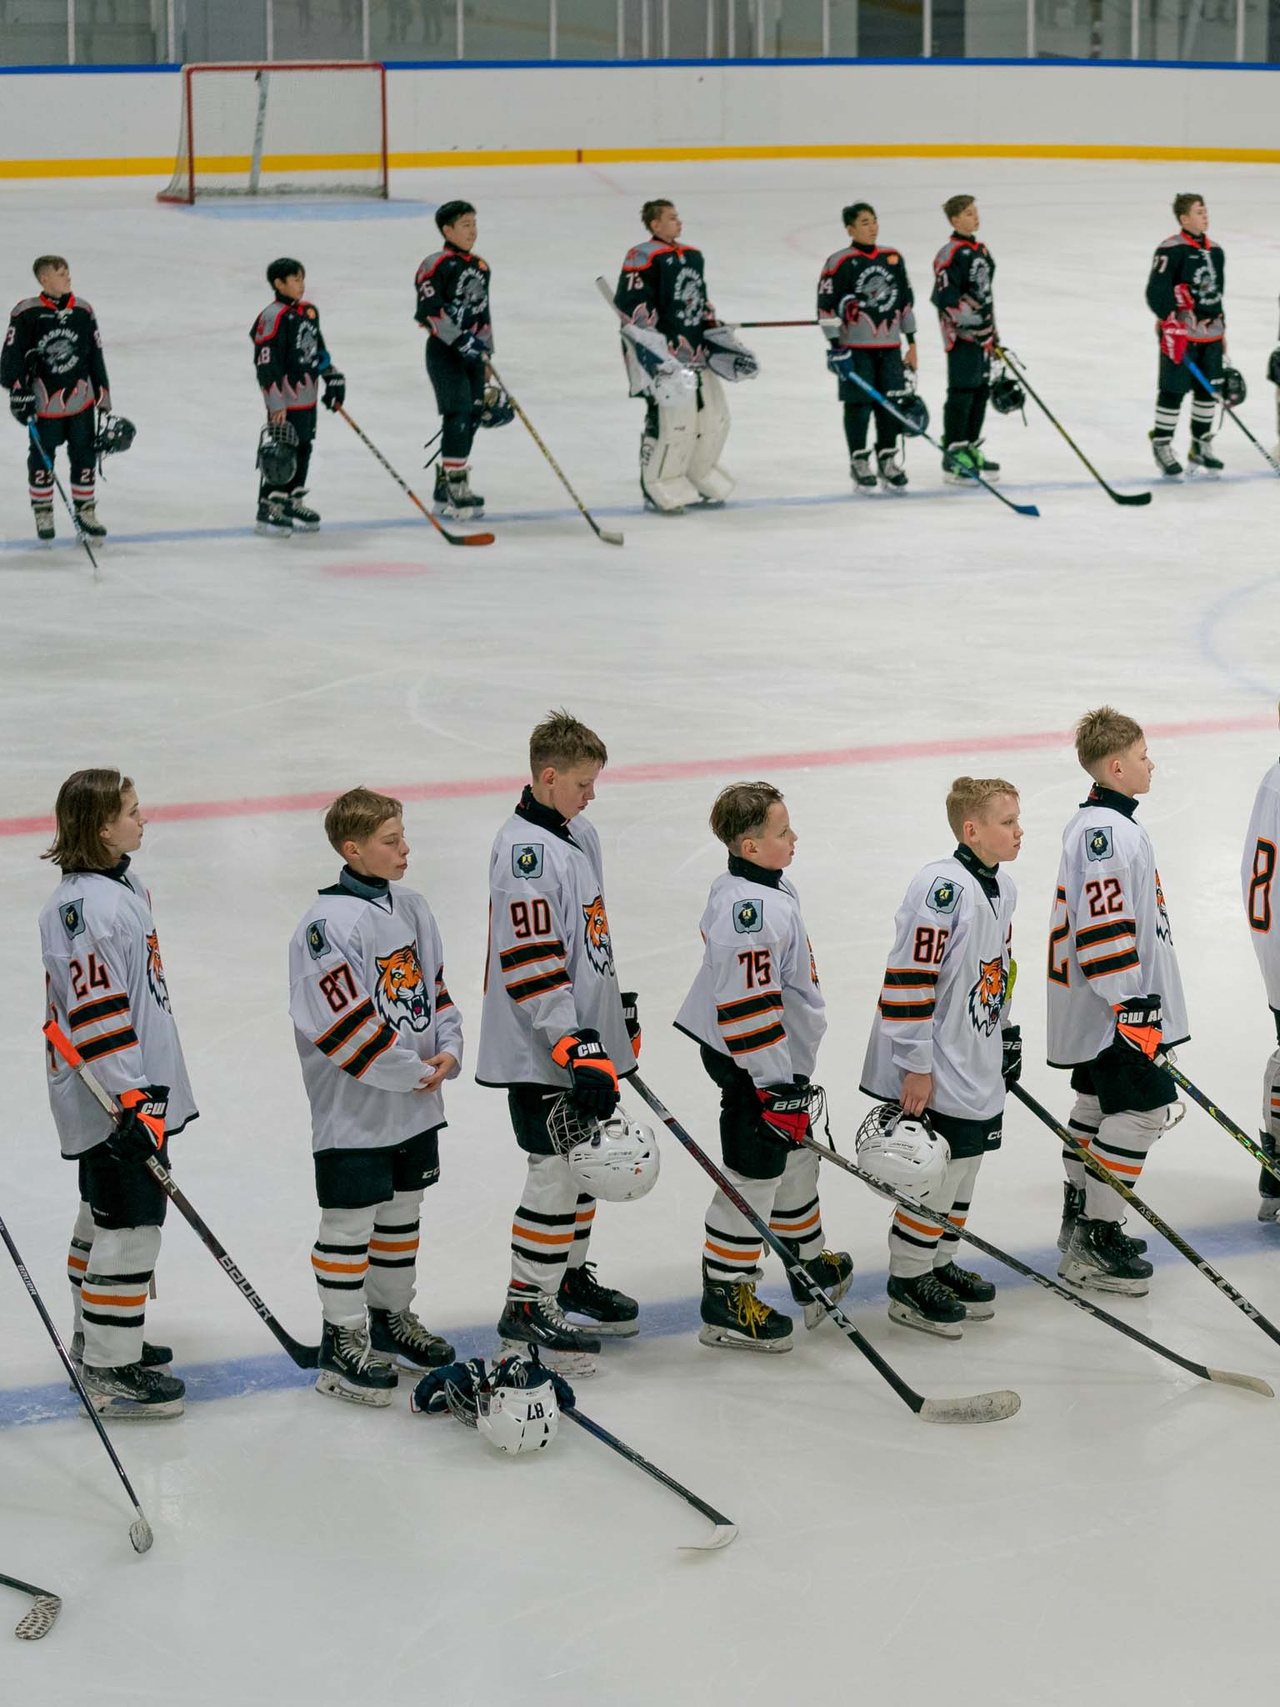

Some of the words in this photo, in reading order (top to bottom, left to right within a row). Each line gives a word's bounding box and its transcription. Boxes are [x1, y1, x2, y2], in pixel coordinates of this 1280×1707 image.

[1085, 876, 1124, 919] 22
[1248, 836, 1278, 935] 8
[509, 898, 552, 940] 90
[69, 952, 111, 1002] 24
[318, 961, 359, 1014] 87
[738, 949, 772, 990] 75
[1118, 1012, 1144, 1024] СШ
[141, 1101, 167, 1116] СШ
[17, 1263, 37, 1296] BAUER
[217, 1253, 275, 1321] BAUER
[787, 1263, 859, 1337] CCM
[1195, 1259, 1260, 1320] CCM
